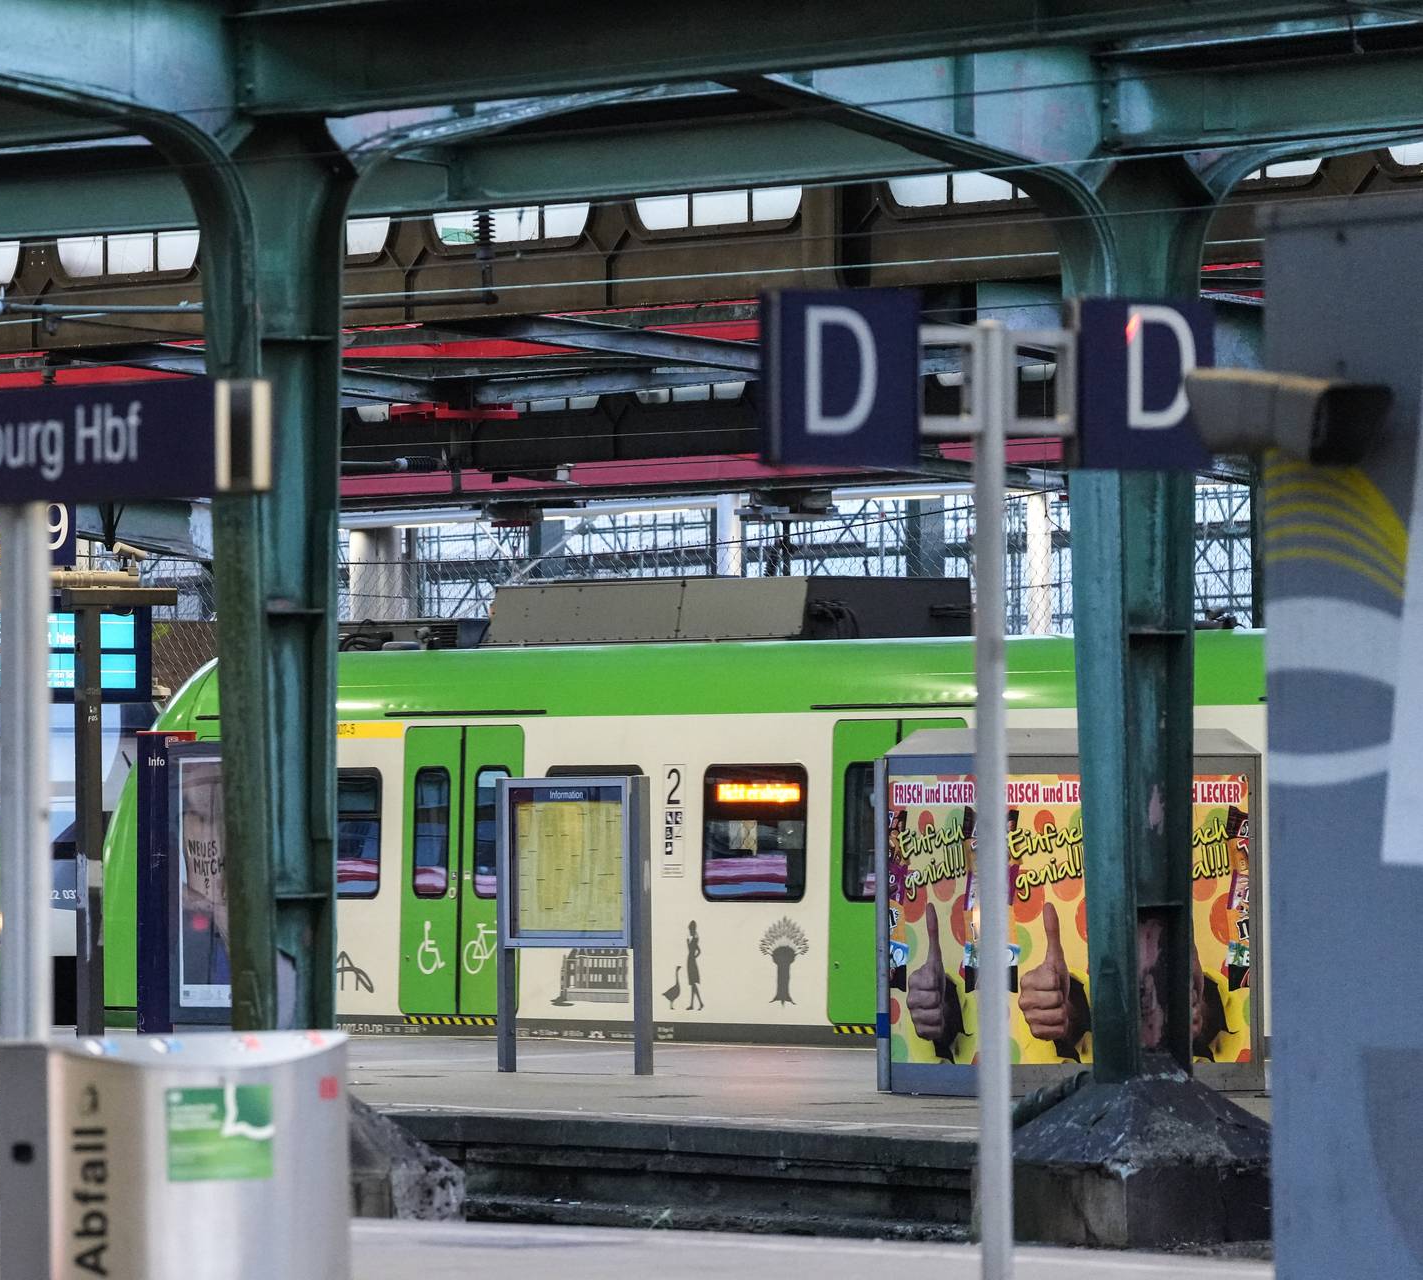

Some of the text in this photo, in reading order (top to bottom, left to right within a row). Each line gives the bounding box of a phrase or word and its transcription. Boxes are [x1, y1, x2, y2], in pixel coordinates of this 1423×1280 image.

[804, 305, 877, 435] D
[1126, 305, 1197, 429] D
[75, 401, 142, 465] Hbf
[46, 504, 69, 550] 9
[148, 756, 165, 767] Info
[549, 790, 584, 800] Information
[666, 768, 681, 805] 2
[894, 784, 974, 804] FRISCH und LECKER
[1007, 784, 1039, 803] RISCH
[1043, 783, 1064, 802] und
[1201, 784, 1240, 803] LECKER
[188, 839, 218, 858] NEUES
[898, 818, 965, 859] Einfach
[193, 857, 225, 878] MATCH
[905, 845, 965, 900] genial!!!
[1015, 845, 1083, 900] genial!
[62, 889, 76, 900] 03
[73, 1128, 109, 1278] Abfall
